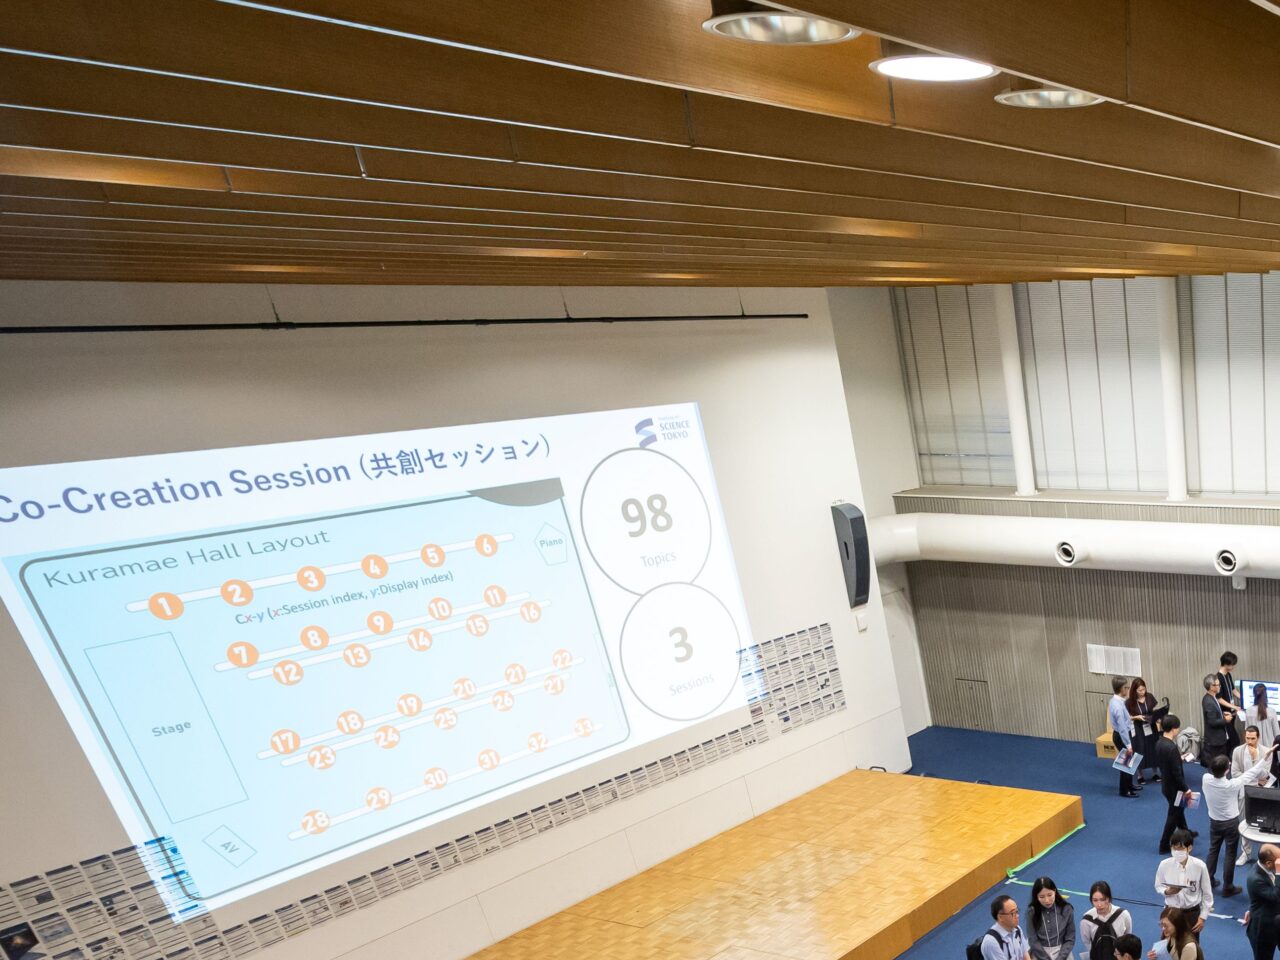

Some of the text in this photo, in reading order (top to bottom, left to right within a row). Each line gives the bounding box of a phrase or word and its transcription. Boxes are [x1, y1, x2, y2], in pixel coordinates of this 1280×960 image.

[229, 463, 351, 494] Session
[621, 494, 673, 538] 98
[43, 530, 331, 588] Kuramae Hall Layout
[539, 537, 564, 548] Piano
[640, 551, 677, 569] Topics
[157, 537, 492, 616] 1 2 3 4 5 6
[235, 611, 264, 624] Cx-y
[331, 591, 368, 605] index,
[420, 570, 454, 586] index)
[233, 588, 502, 665] 7 8 9 10 11
[275, 604, 539, 683] 12 13 14 15 16
[669, 626, 694, 663] 3
[272, 652, 571, 752] 17 18 19 20 21 22
[669, 673, 715, 697] Sessions
[152, 721, 192, 737] Stage
[309, 677, 562, 768] 23 24 25 26 27
[302, 811, 329, 832] 28
[367, 789, 390, 809] 29
[423, 770, 447, 789] 30
[480, 749, 499, 768] 31
[220, 841, 240, 854] AV
